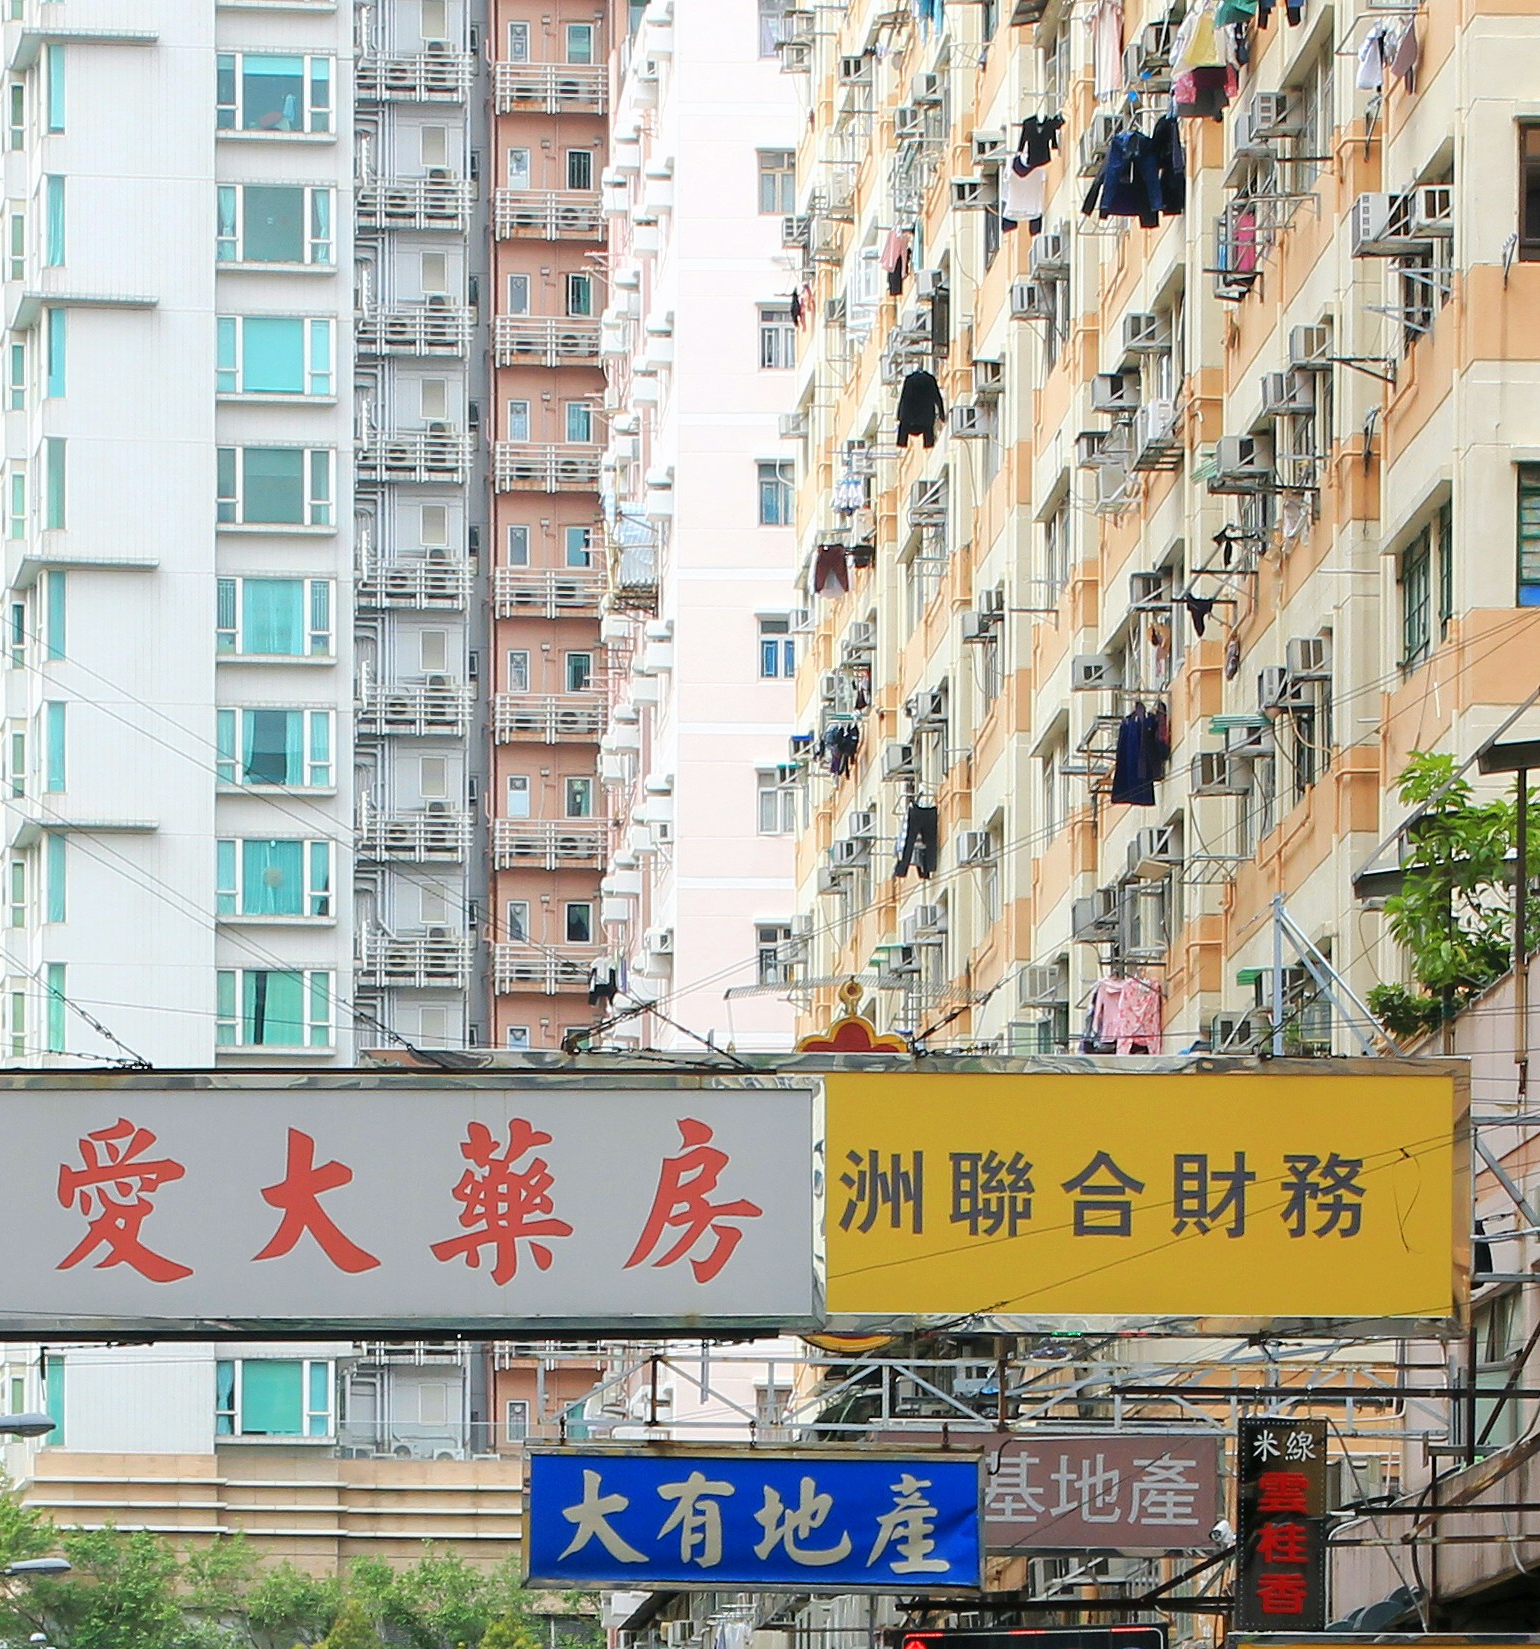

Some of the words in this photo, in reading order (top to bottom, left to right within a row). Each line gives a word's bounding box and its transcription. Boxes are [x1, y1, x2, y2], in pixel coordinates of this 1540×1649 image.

[838, 1149, 1367, 1237] 洲聯合財務
[1252, 1429, 1316, 1462] 米線
[557, 1468, 951, 1575] 大有地產
[985, 1454, 1201, 1527] 基地產
[1256, 1472, 1309, 1615] 雲桂香
